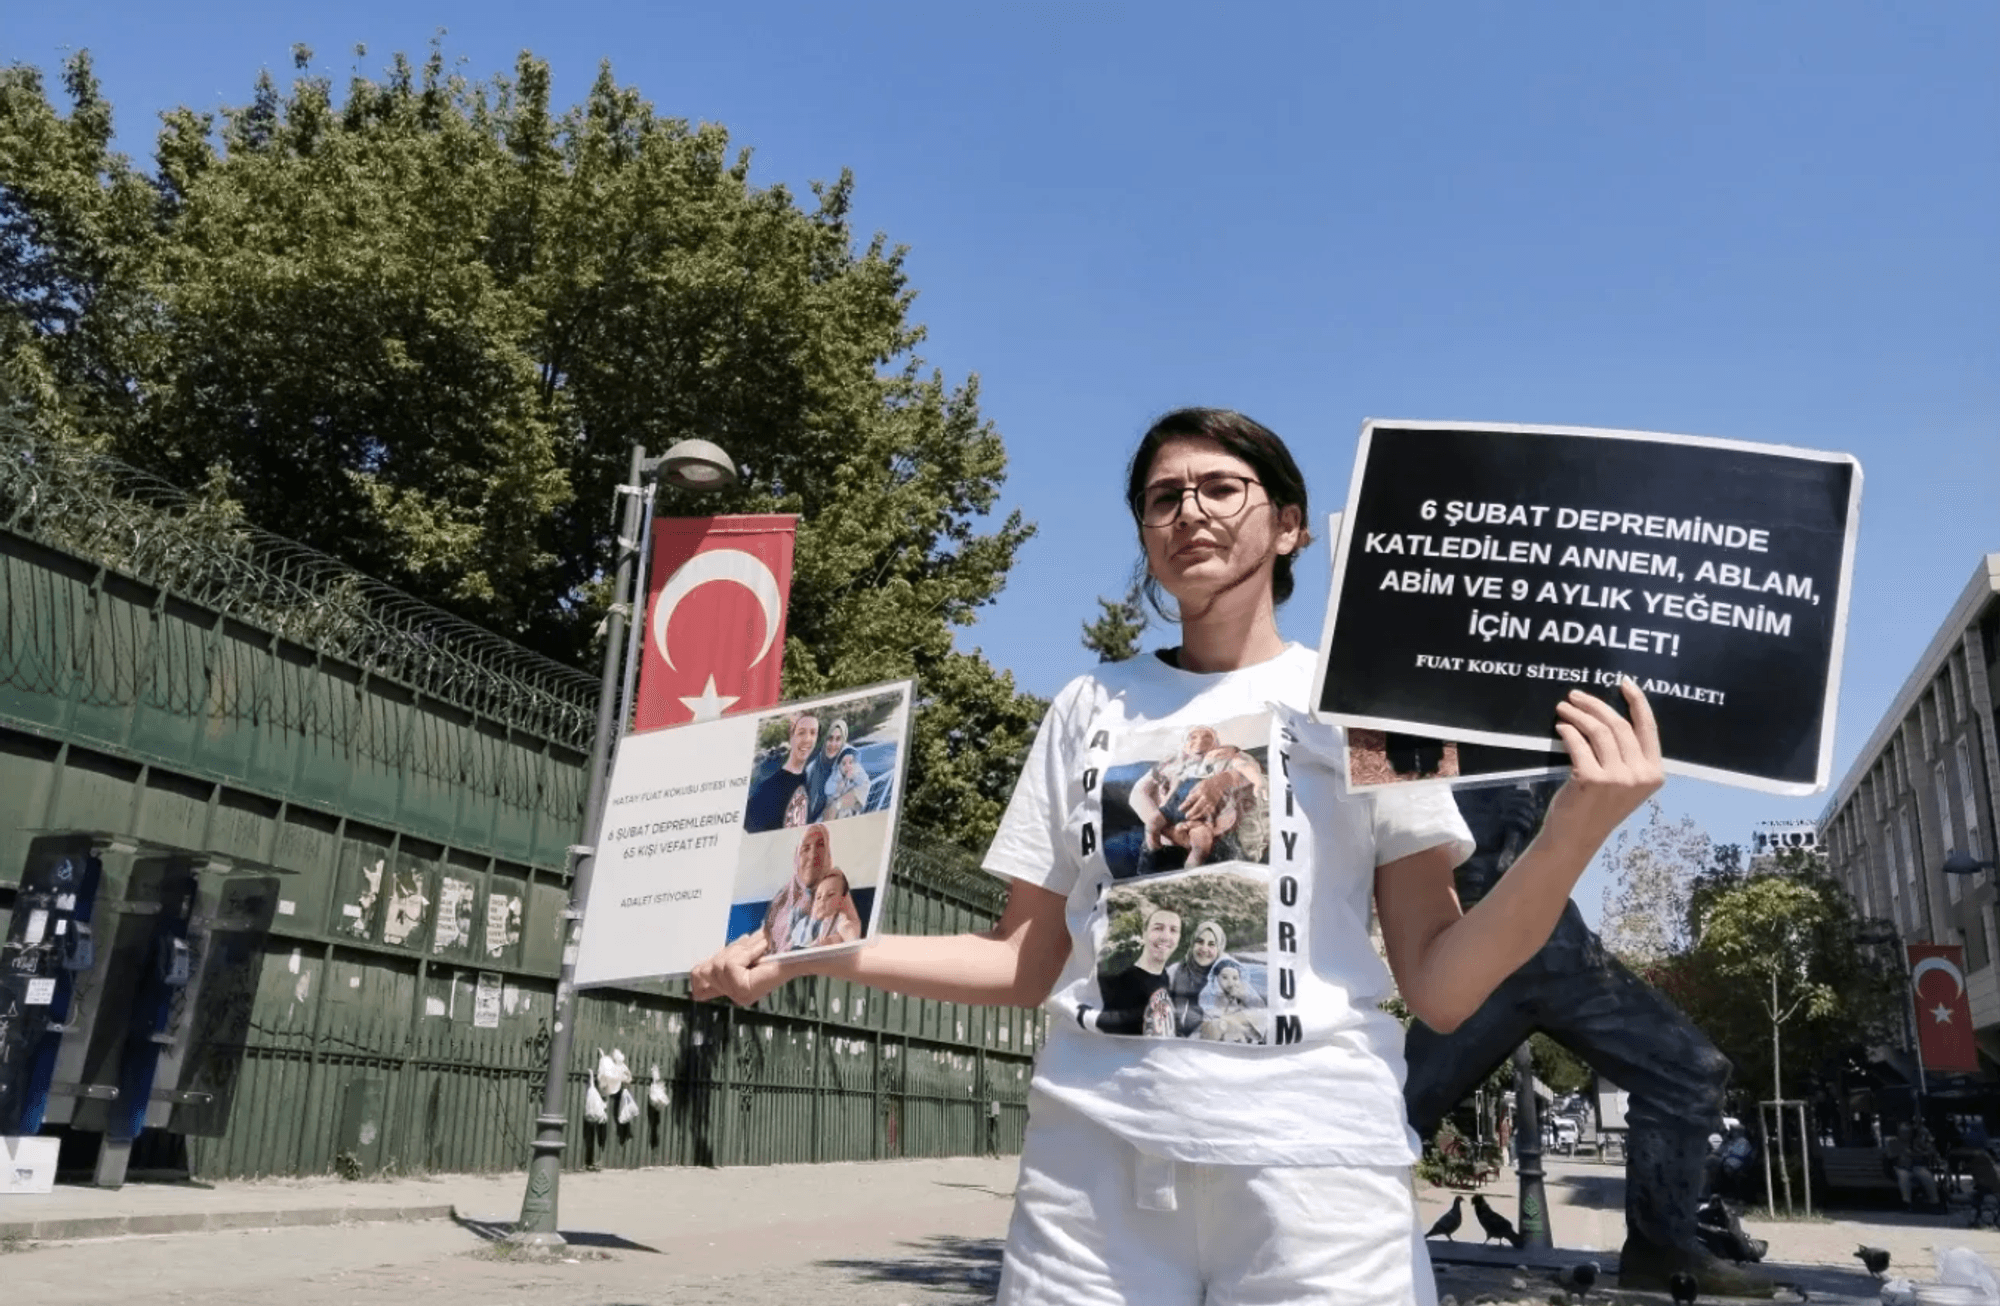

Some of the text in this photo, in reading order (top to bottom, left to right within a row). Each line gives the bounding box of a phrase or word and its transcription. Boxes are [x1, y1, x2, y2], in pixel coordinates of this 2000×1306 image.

[1420, 499, 1770, 553] 6 ŞUBAT DEPREMİNDE
[1364, 532, 1821, 607] KATLEDİLEN ANNEM, ABLAM,
[1379, 567, 1792, 637] ABİM VE 9 AYLIK YEĞENİM
[1469, 608, 1680, 657] İÇİN ADALET!
[1416, 654, 1464, 671] FUAT
[1467, 659, 1523, 677] KOKU
[1526, 664, 1590, 683] SİTESİ
[1641, 678, 1725, 706] ADALET!
[615, 824, 651, 842] ŞUBAT
[623, 847, 636, 859] 65
[659, 838, 694, 854] VEFAT
